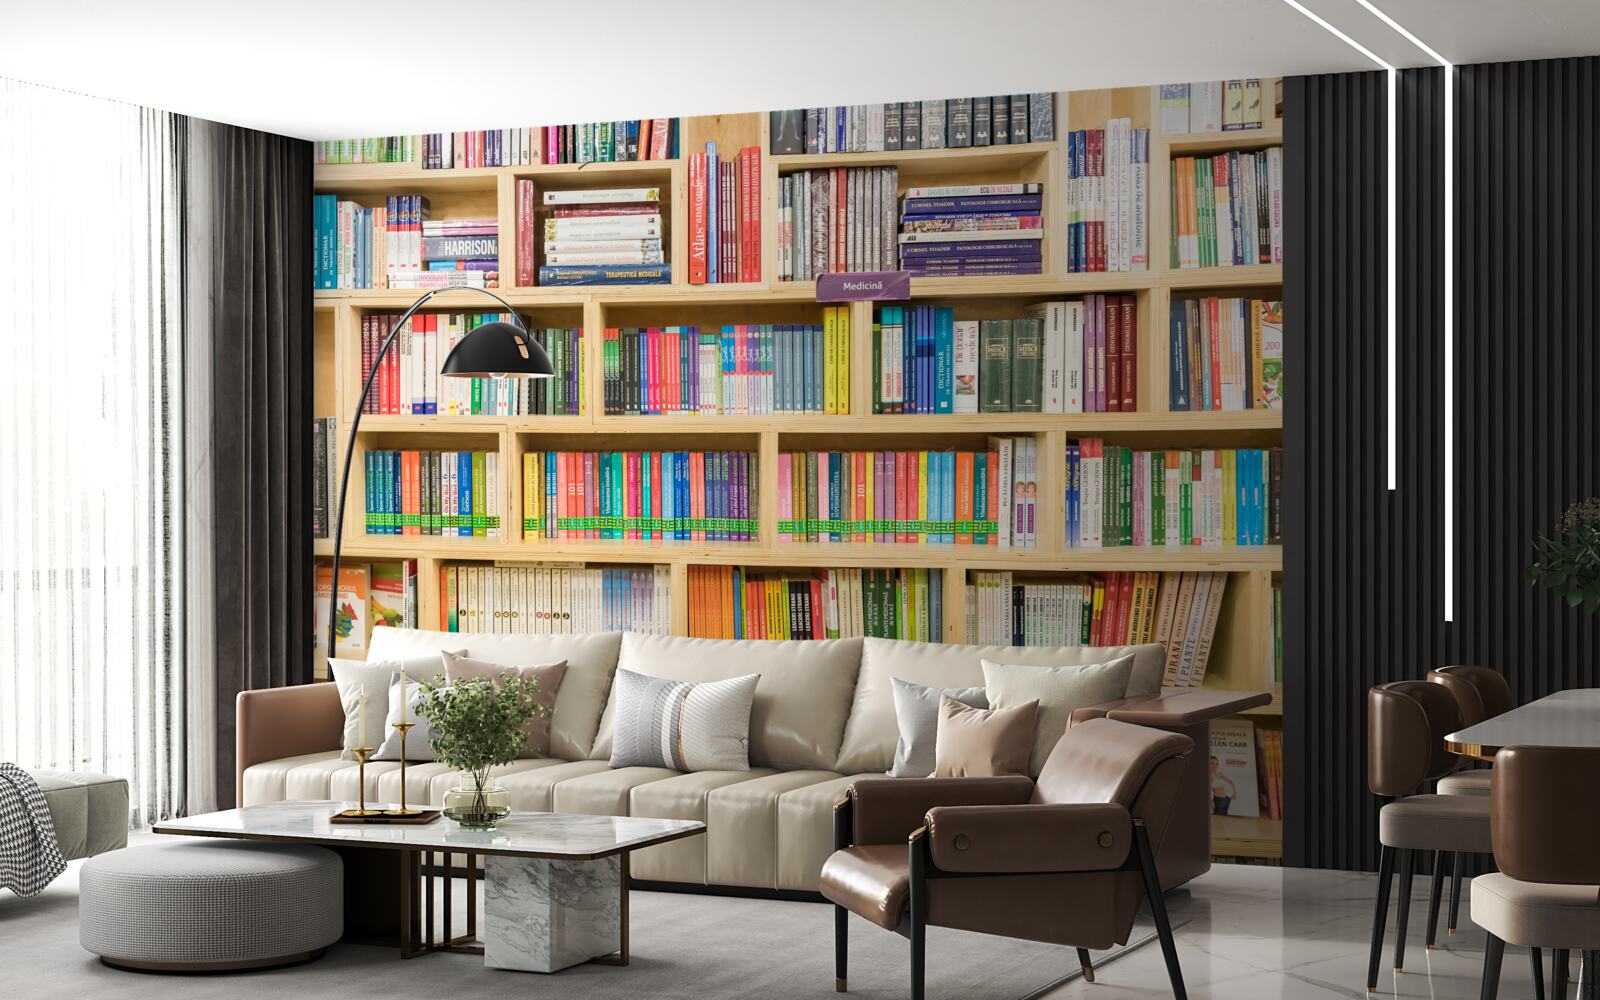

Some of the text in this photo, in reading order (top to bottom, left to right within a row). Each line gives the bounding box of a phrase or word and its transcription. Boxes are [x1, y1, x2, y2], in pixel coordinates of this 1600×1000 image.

[1136, 204, 1144, 248] anatomie
[445, 240, 494, 255] HARRISON
[692, 228, 705, 261] Atlas
[844, 281, 882, 291] Medicină
[1181, 638, 1196, 676] PLANTE
[1194, 638, 1210, 676] PLANTE
